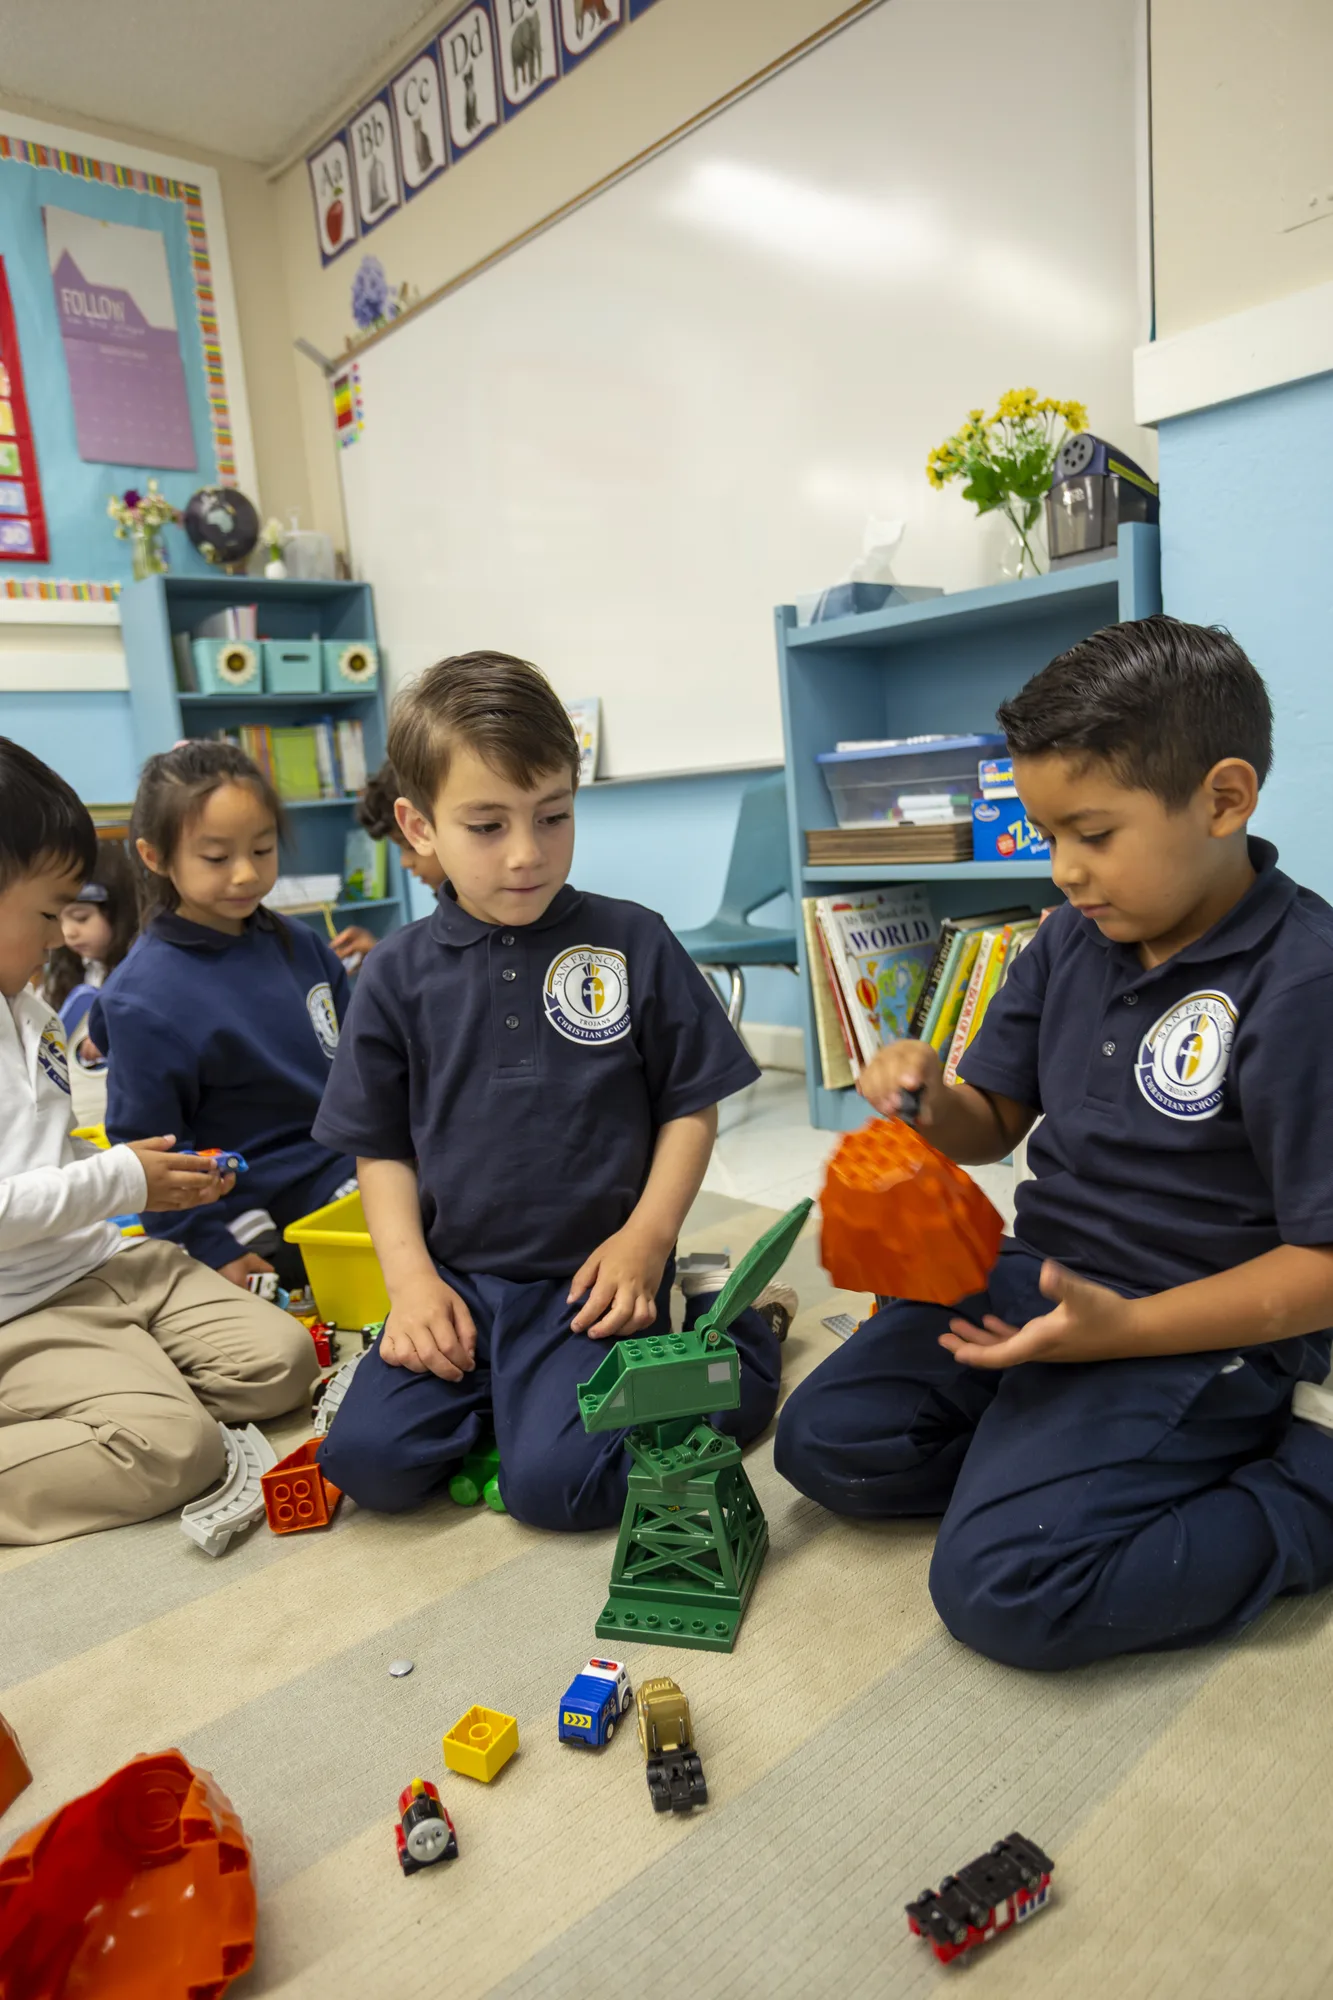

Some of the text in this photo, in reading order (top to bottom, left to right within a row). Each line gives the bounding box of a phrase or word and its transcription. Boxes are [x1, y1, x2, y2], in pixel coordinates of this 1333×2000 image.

[450, 15, 483, 77] Dd
[404, 75, 431, 117] Cc
[357, 113, 385, 159] Bb
[321, 158, 344, 196] Aa
[849, 920, 931, 951] WORLD
[554, 953, 629, 987] SAN FRANCISCO
[557, 1016, 602, 1039] CHRISTIAN
[579, 1018, 611, 1027] TROJANS
[1158, 1013, 1180, 1040] SAN
[1144, 1074, 1185, 1112] CHRISTIAN
[1164, 1082, 1199, 1097] TROJANS
